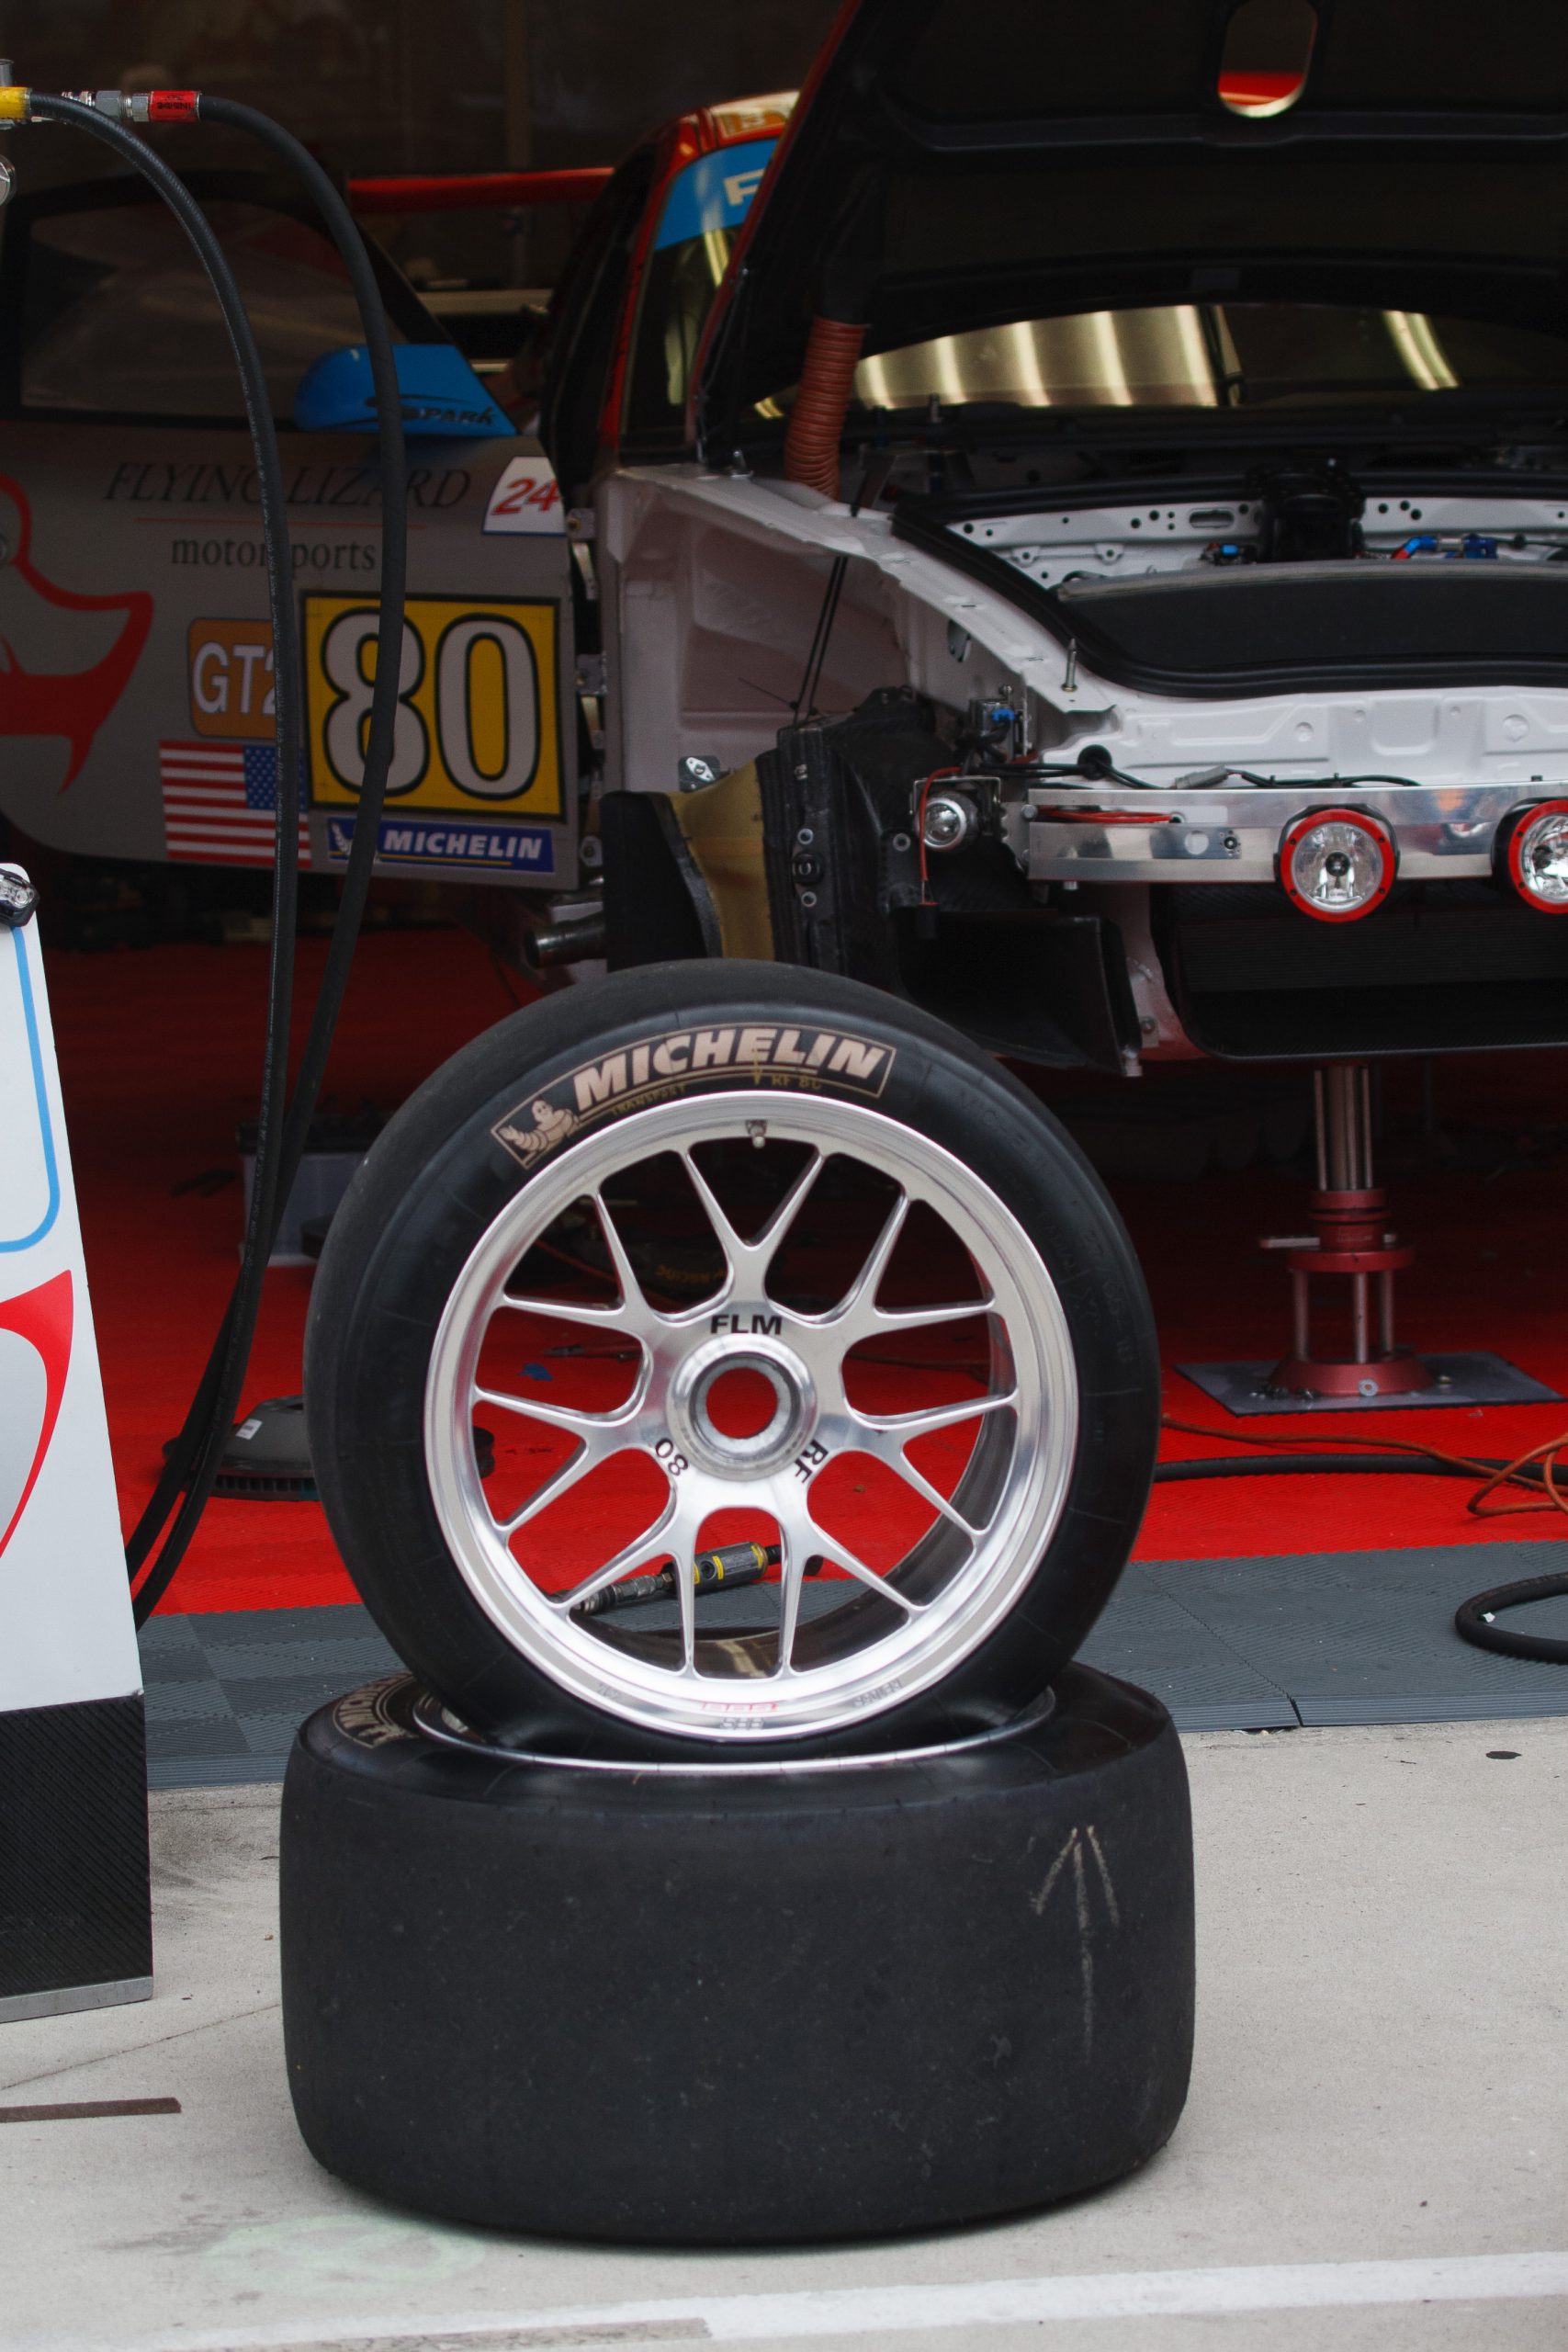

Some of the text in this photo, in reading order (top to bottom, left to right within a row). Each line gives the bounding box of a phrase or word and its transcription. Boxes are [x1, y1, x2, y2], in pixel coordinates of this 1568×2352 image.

[285, 465, 471, 509] LIZRD
[493, 476, 559, 515] 24
[171, 537, 377, 575] motorports
[321, 606, 540, 801] 80
[383, 829, 543, 862] MICHELIN
[571, 1027, 888, 1113] MICHELIN
[710, 1314, 784, 1336] FLM
[654, 1437, 690, 1477] 80
[794, 1439, 829, 1484] RF
